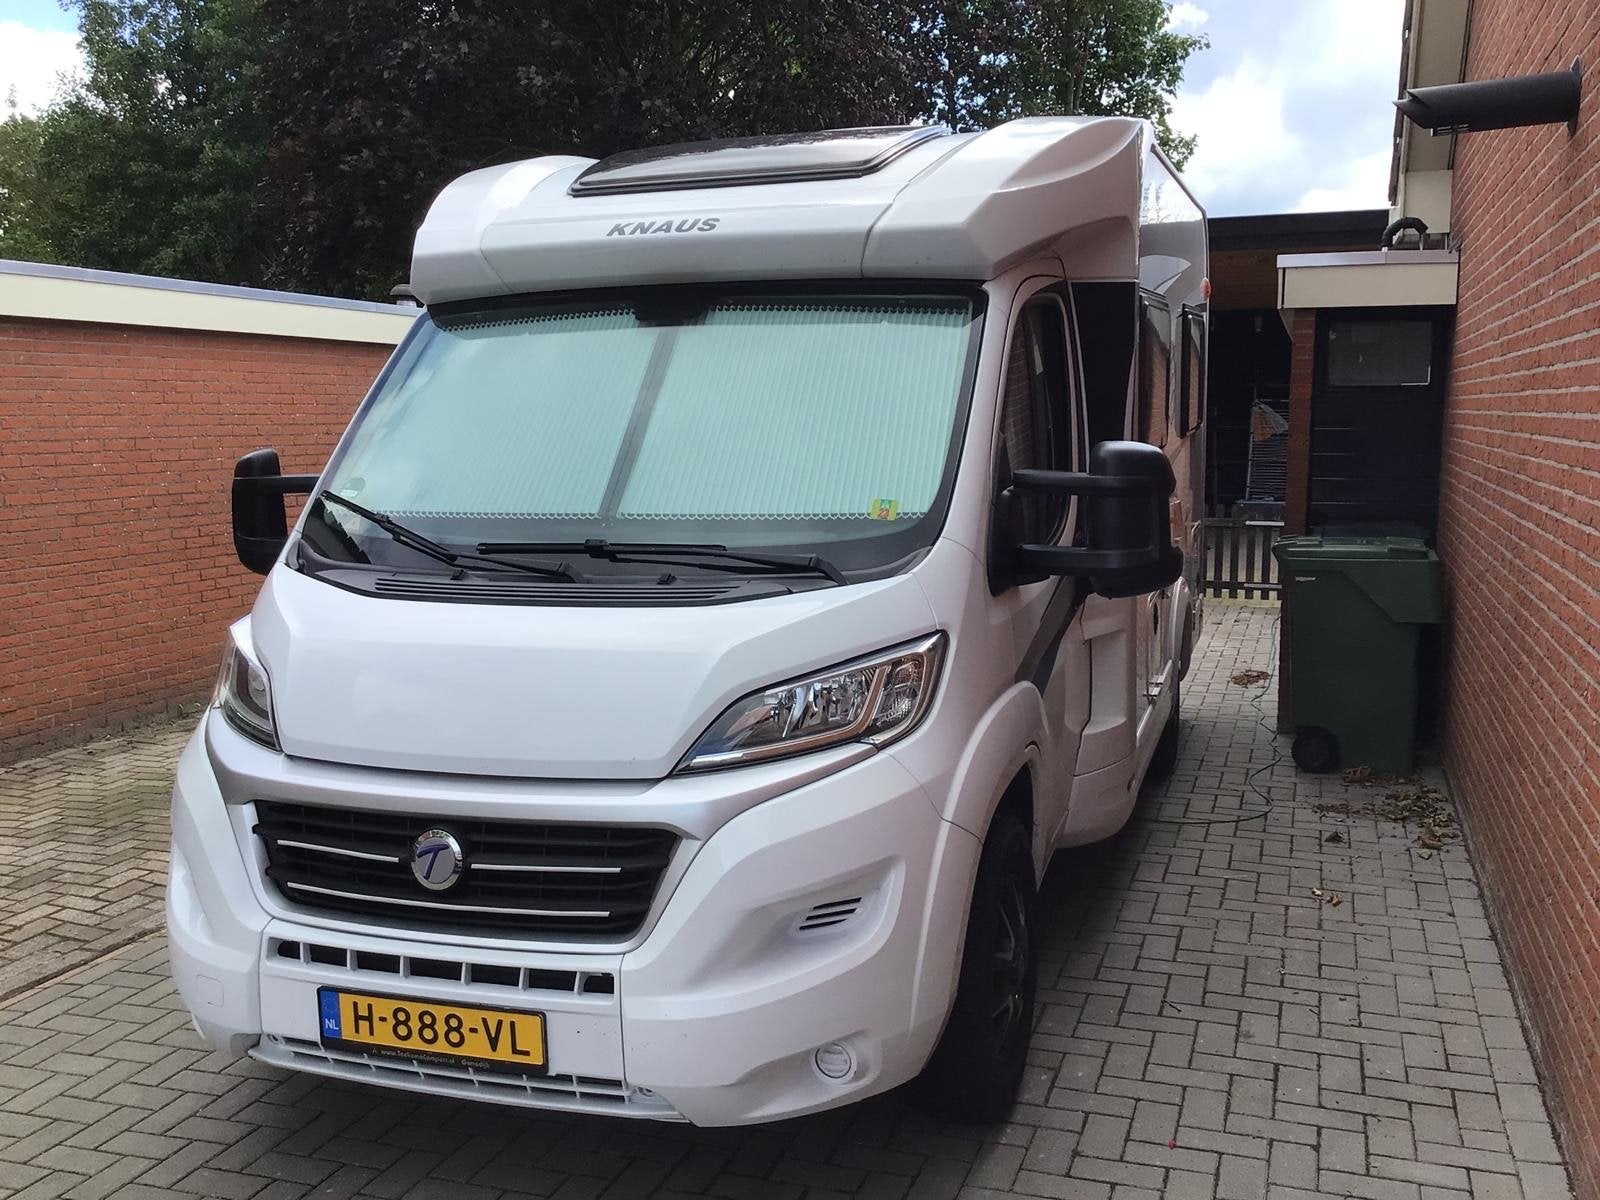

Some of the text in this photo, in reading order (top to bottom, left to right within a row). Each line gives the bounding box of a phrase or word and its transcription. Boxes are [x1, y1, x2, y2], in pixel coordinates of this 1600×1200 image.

[606, 217, 720, 236] KNAUS
[325, 1018, 340, 1030] NL
[352, 1000, 531, 1057] H-888-VL
